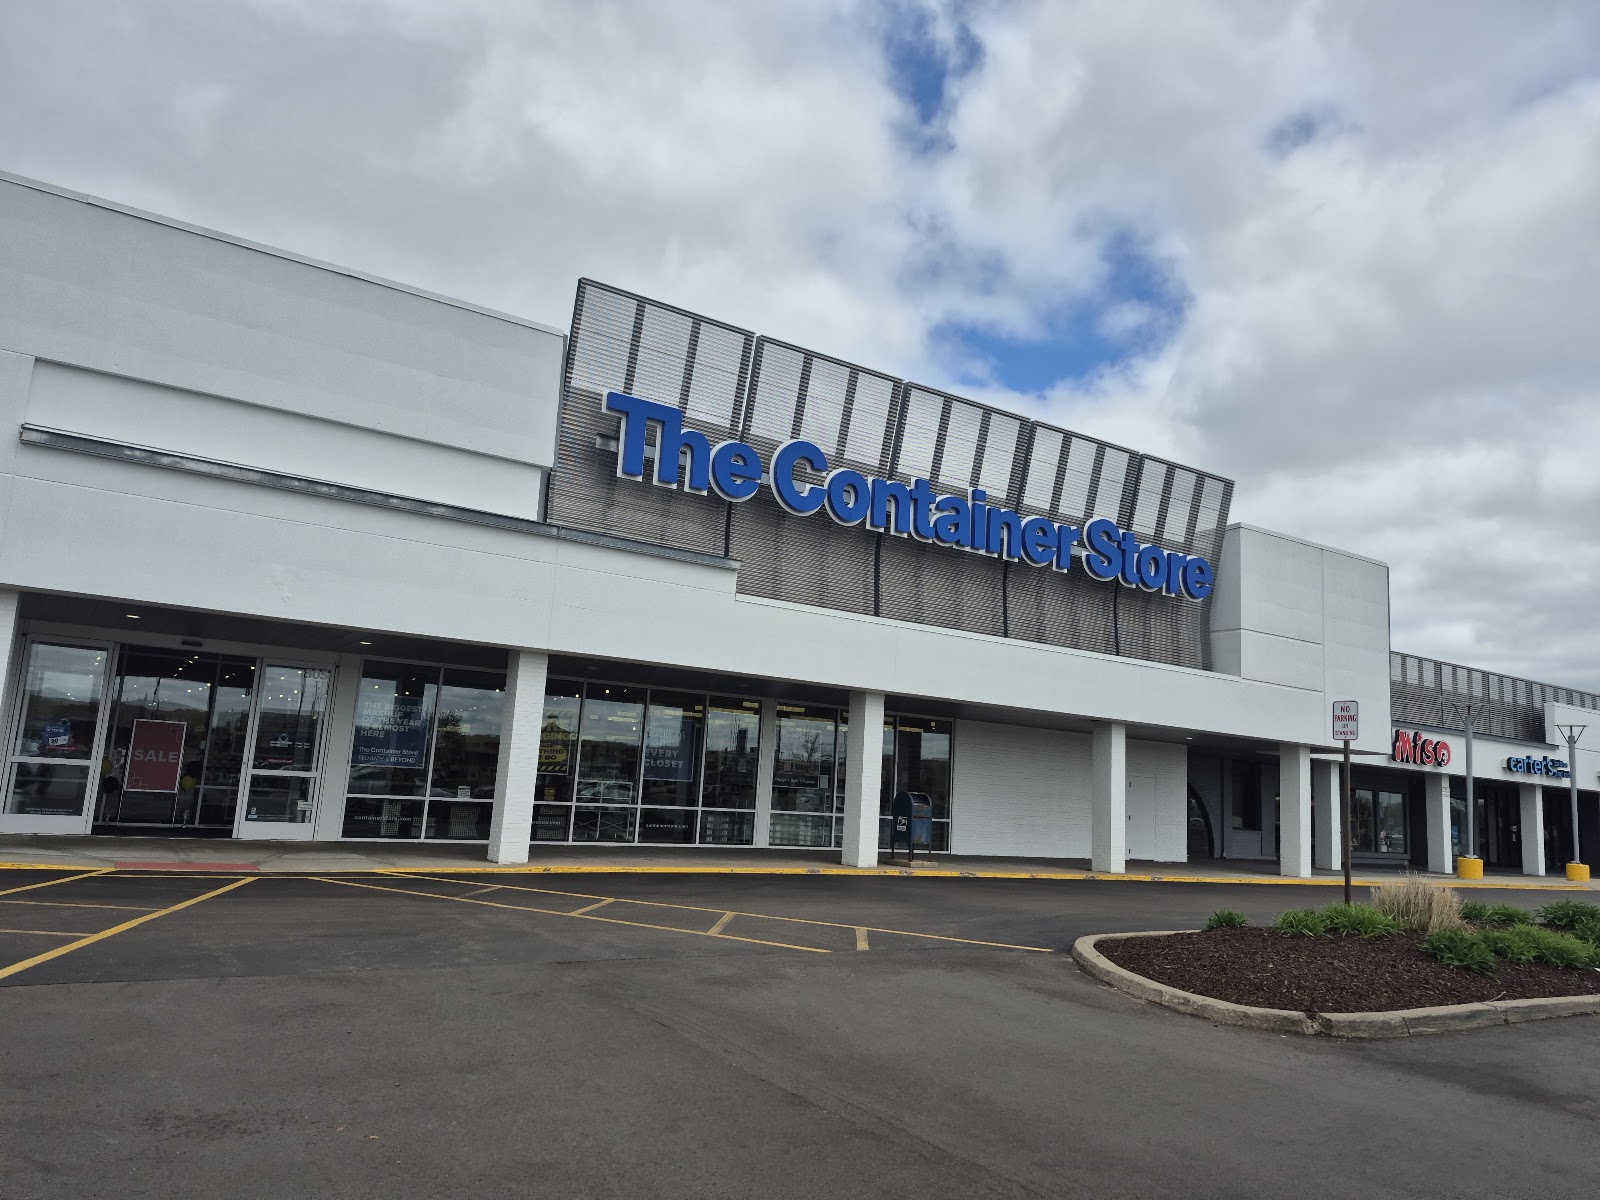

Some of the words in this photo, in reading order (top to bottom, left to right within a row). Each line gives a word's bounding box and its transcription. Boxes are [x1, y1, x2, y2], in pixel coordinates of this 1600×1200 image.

[603, 391, 763, 502] The
[771, 439, 1082, 574] Container
[1082, 518, 1214, 601] Store
[365, 701, 382, 710] THE
[384, 703, 423, 713] BIGGEST
[1340, 705, 1351, 713] NO
[362, 709, 404, 718] MASHUP
[1334, 714, 1357, 722] PARKING
[378, 716, 396, 725] THE
[396, 718, 421, 727] YEAR
[372, 723, 411, 733] ALMOST
[360, 729, 386, 738] HERE
[133, 749, 179, 763] SALE
[371, 747, 401, 755] Container
[645, 748, 679, 758] EVERY
[644, 759, 684, 769] CLOSET
